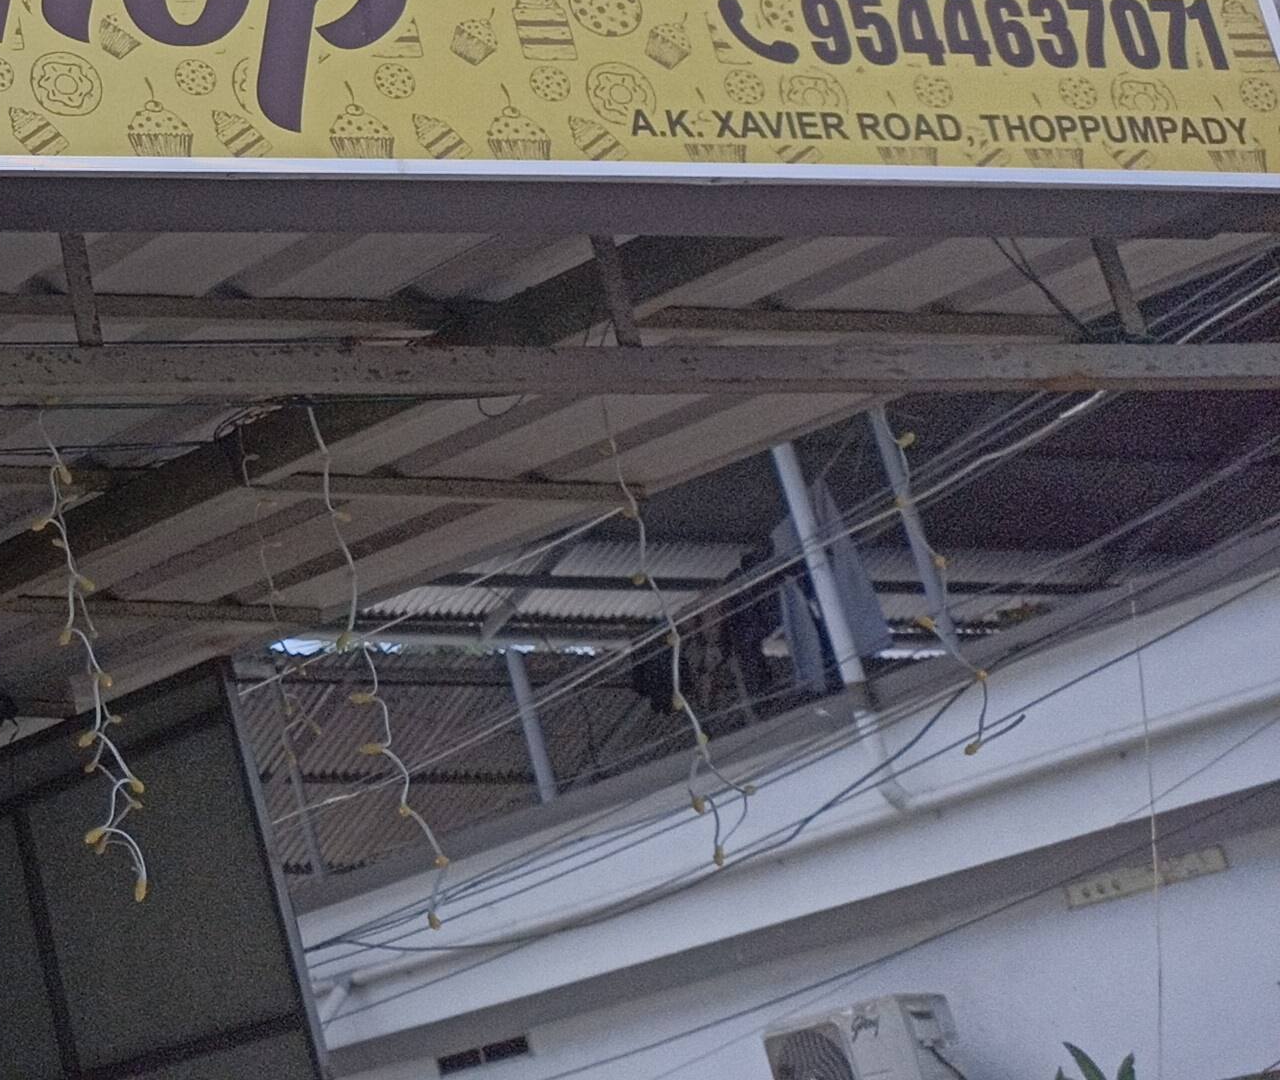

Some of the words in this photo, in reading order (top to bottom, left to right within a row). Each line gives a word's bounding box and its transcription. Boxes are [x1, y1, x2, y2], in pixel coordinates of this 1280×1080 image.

[631, 108, 704, 138] A.K.
[711, 110, 848, 140] XAVIER
[856, 112, 974, 147] ROAD,
[979, 114, 1247, 145] THOPPUMPADY
